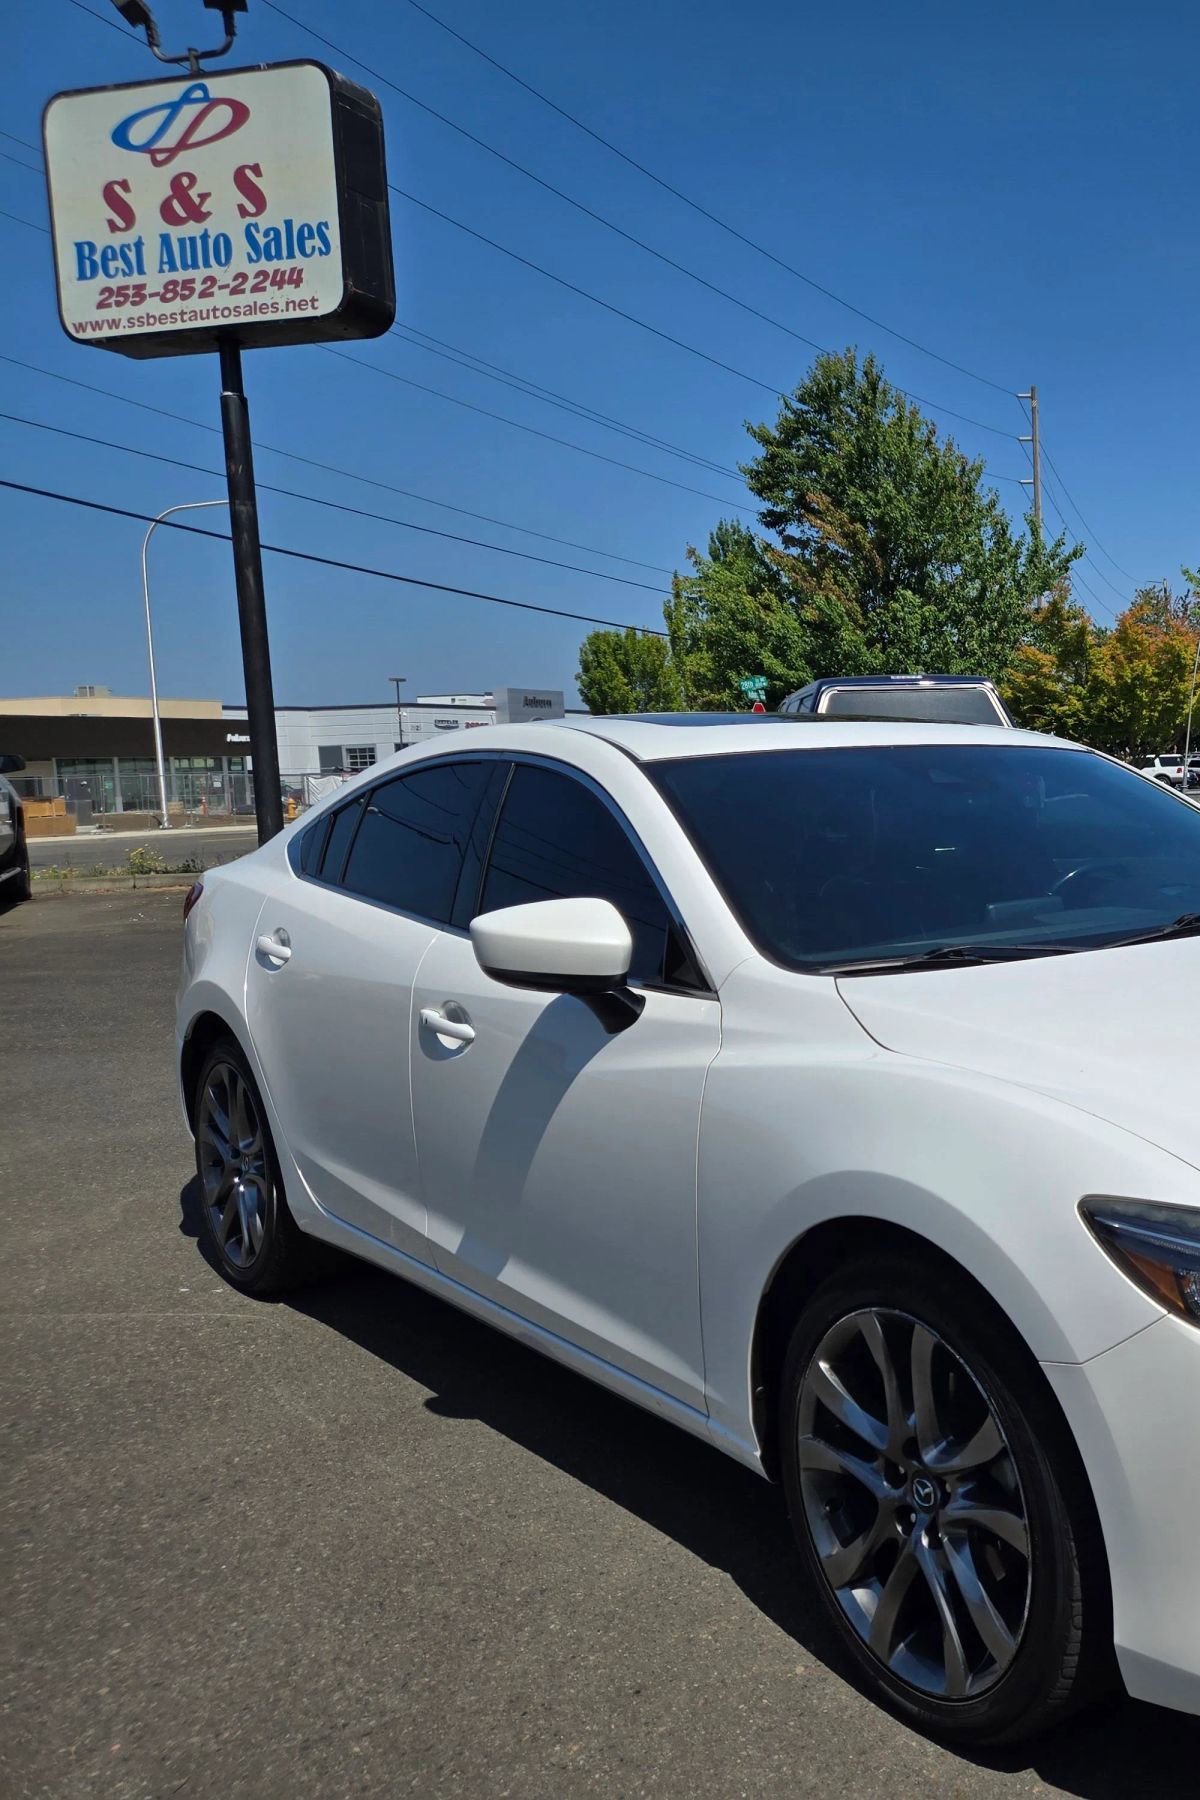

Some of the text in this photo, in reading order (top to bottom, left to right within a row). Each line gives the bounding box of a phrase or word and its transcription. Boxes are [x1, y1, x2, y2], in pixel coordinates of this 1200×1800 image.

[102, 163, 267, 233] S & S
[74, 219, 332, 281] Best Auto Sales
[96, 266, 304, 310] 253-852-2244
[71, 296, 319, 334] www.ssbestautosales.net
[522, 695, 552, 709] Auburn
